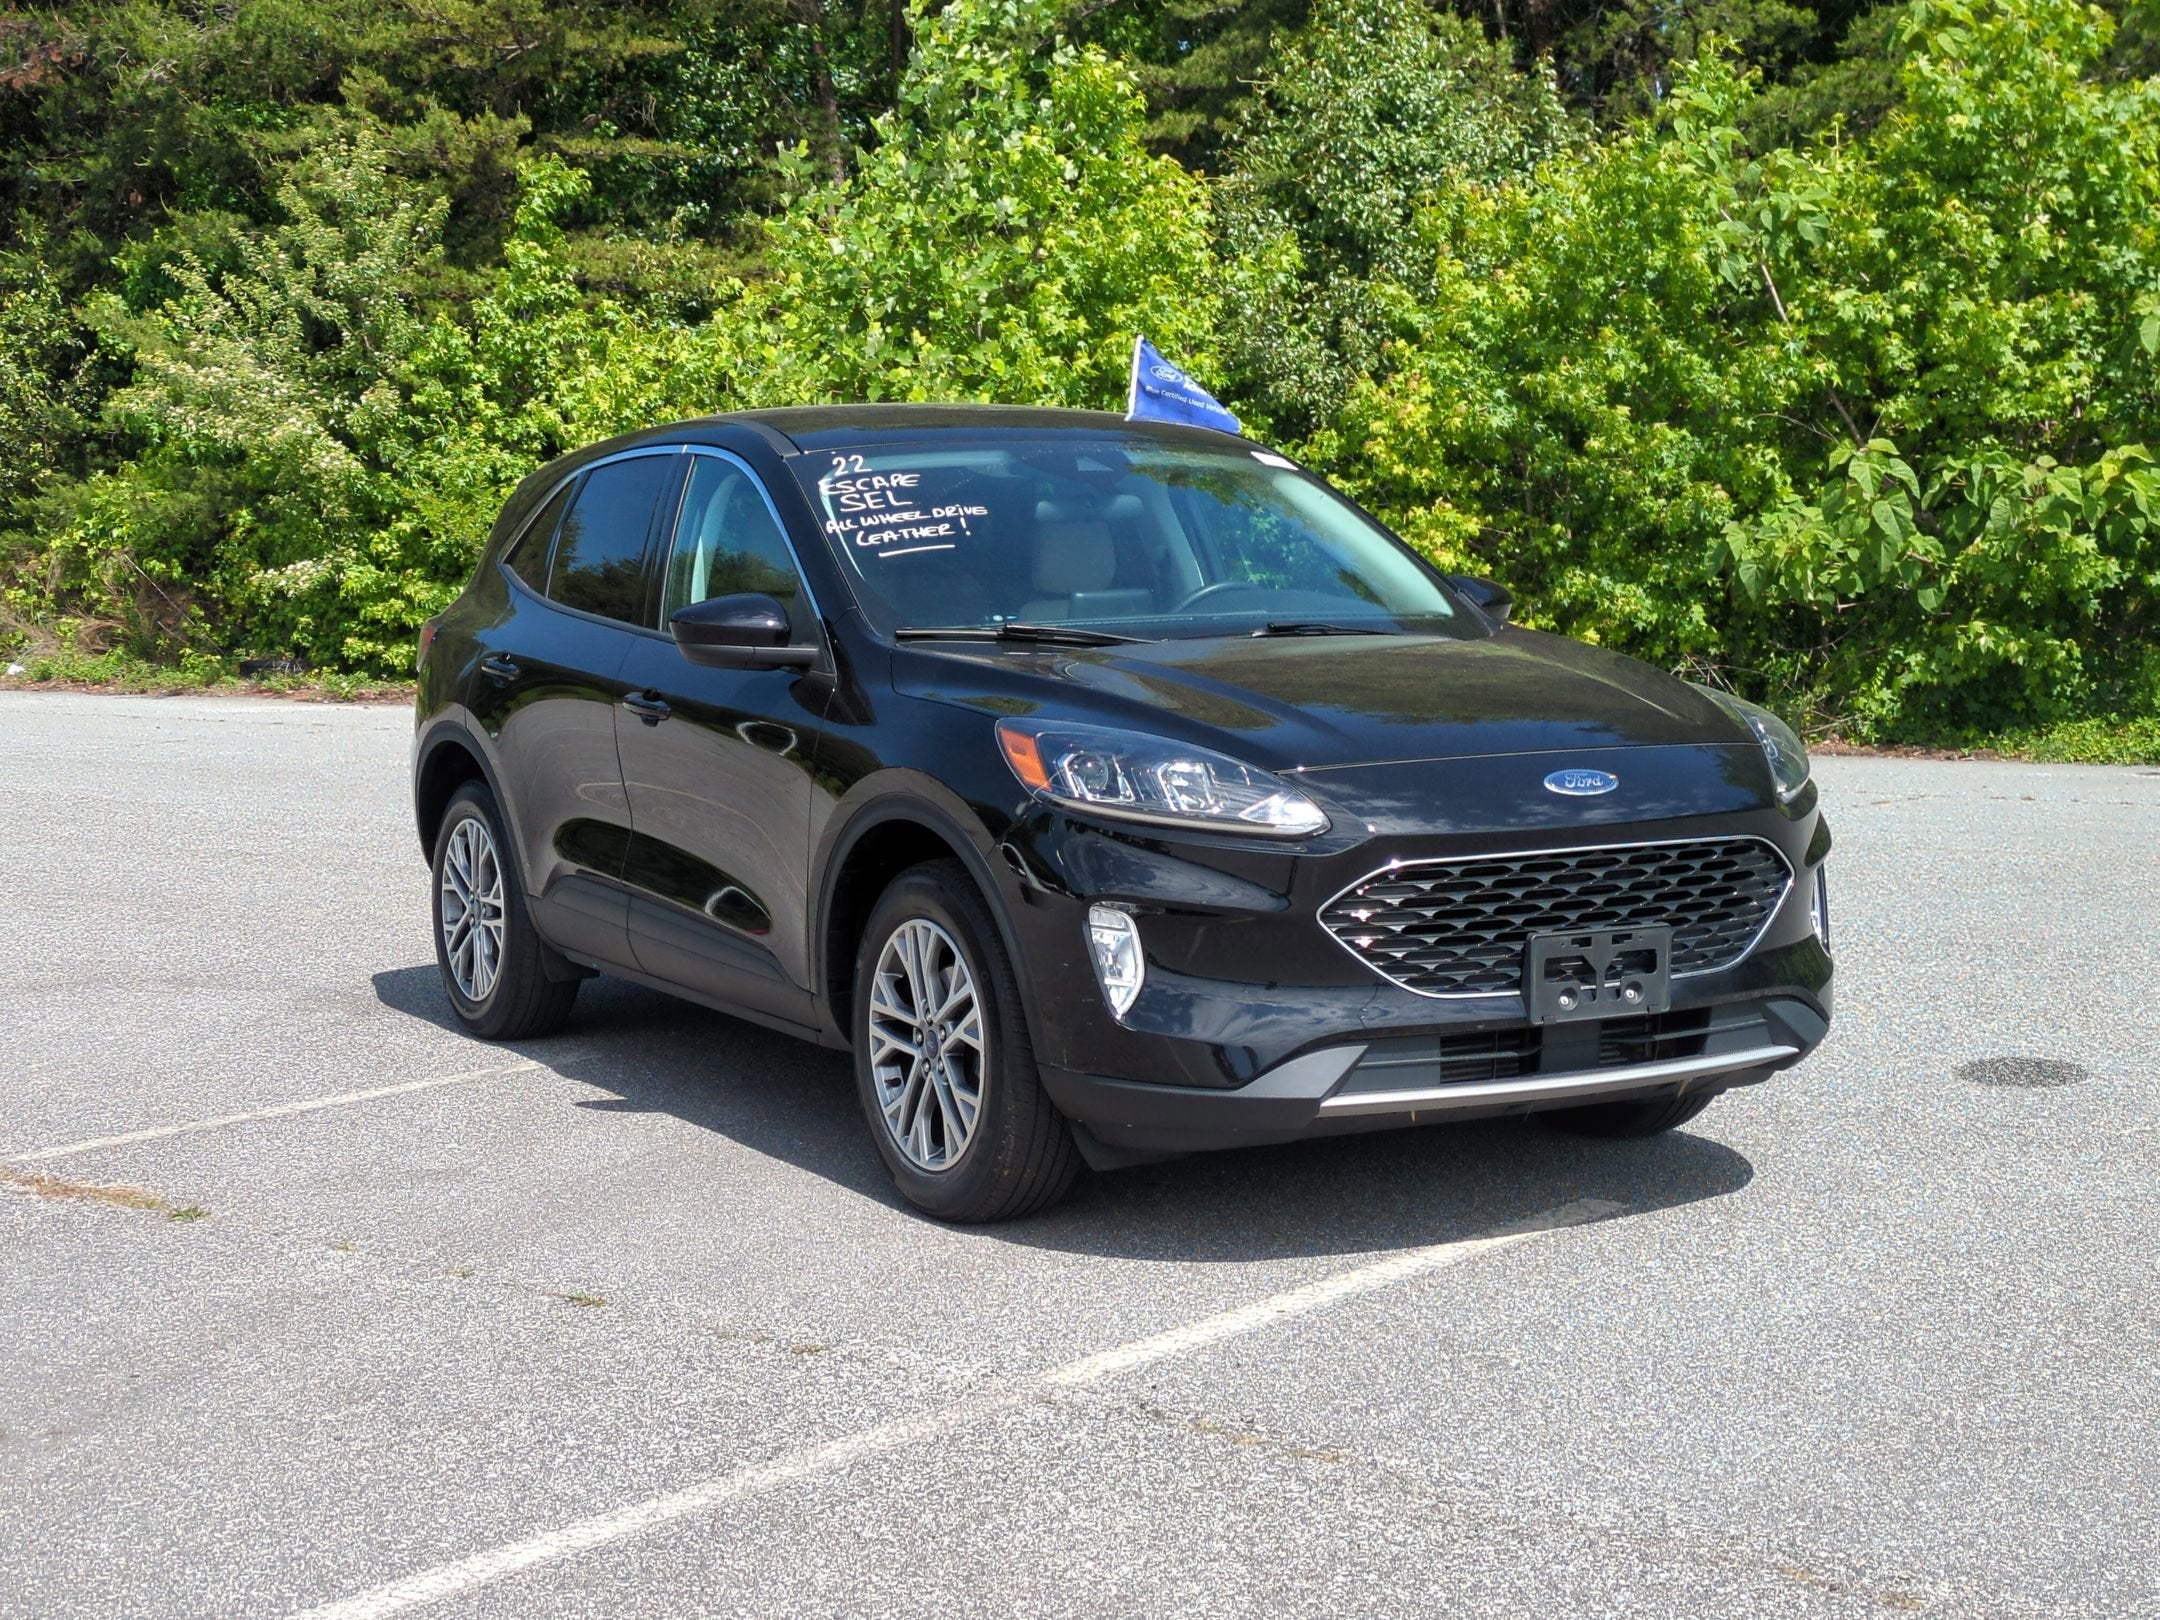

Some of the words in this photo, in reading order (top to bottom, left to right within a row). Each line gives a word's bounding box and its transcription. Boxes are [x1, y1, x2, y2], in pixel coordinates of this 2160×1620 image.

[1160, 390, 1188, 403] Certified
[1188, 399, 1205, 408] Used
[832, 455, 872, 476] 22
[818, 473, 921, 496] ESCAPE
[840, 490, 913, 512] SEL
[826, 520, 859, 535] ALL
[862, 510, 931, 527] WHEEL
[932, 504, 988, 518] DRIVE
[1564, 772, 1604, 788] Ford
